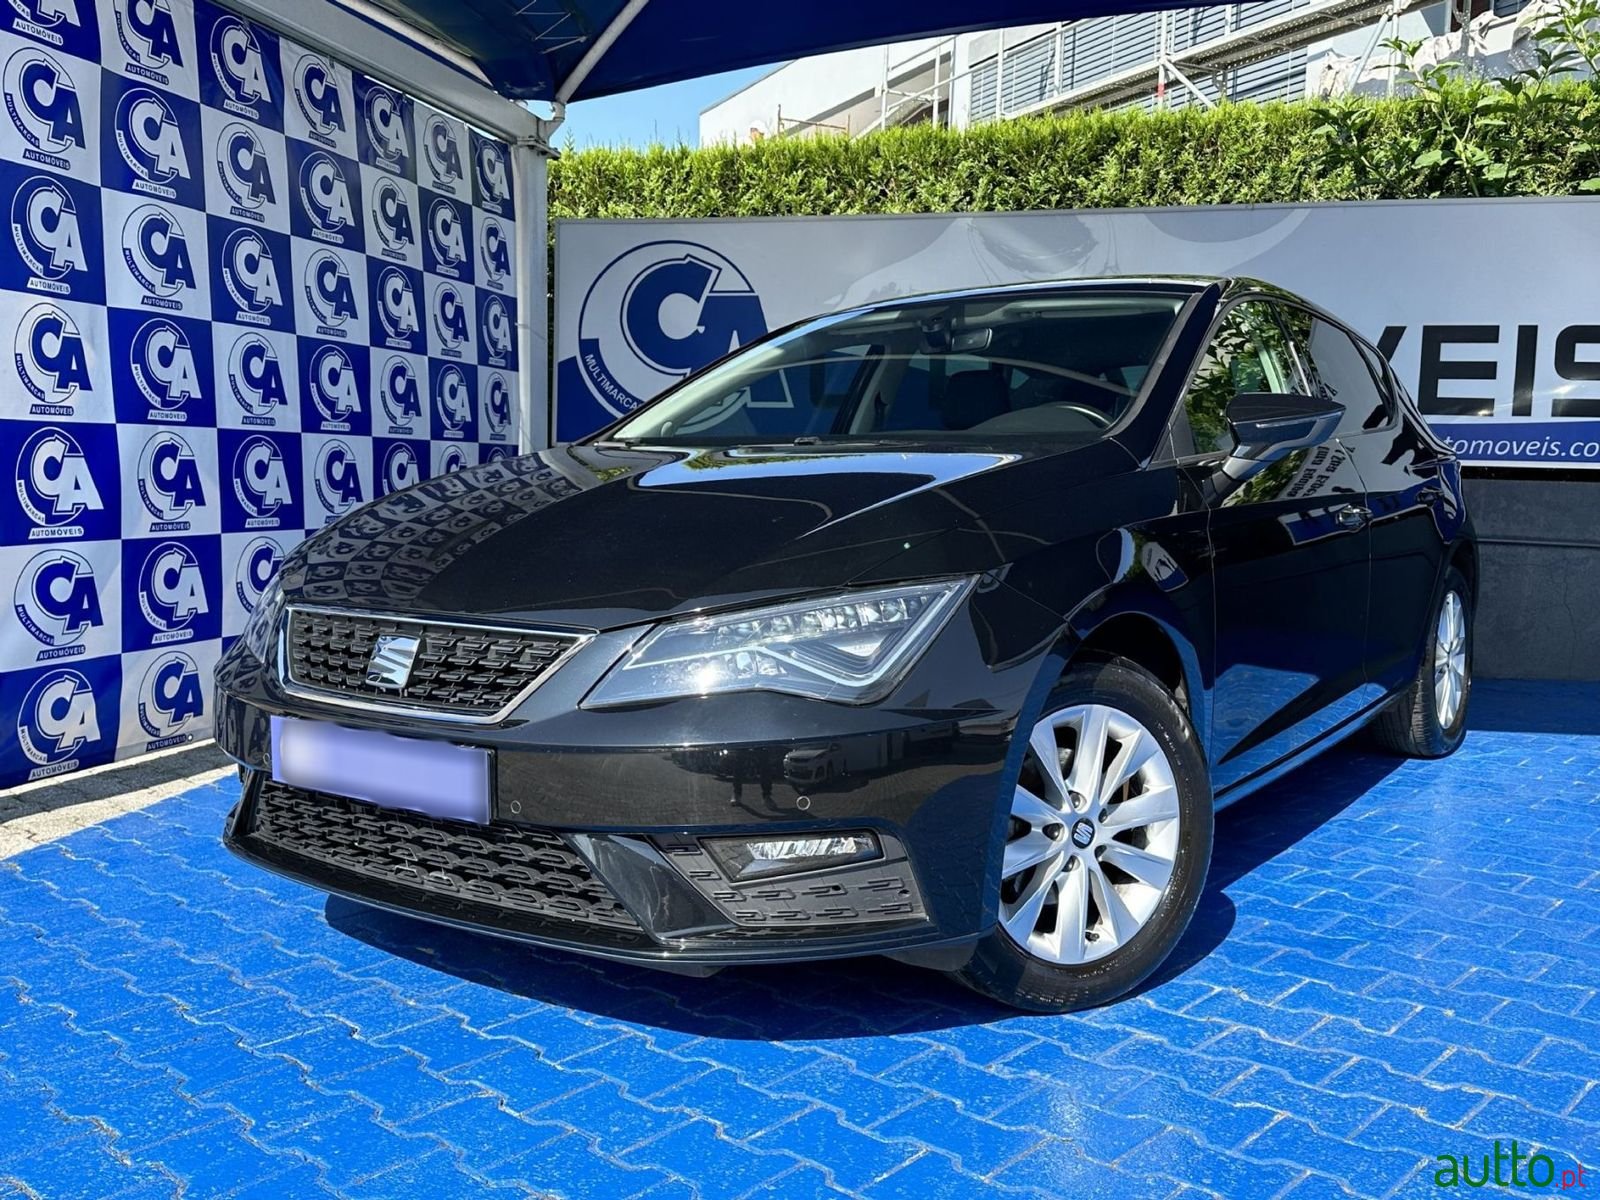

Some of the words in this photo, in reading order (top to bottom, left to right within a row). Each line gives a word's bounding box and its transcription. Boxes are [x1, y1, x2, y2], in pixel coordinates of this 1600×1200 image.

[224, 28, 271, 102] CA
[6, 95, 40, 147] MULTIMARCAS
[23, 63, 86, 149] CA
[304, 67, 346, 132] CA
[374, 97, 409, 158] CA
[131, 100, 190, 178] CA
[230, 134, 276, 204] CA
[433, 125, 463, 180] CA
[312, 163, 355, 226] CA
[381, 187, 415, 245] CA
[14, 226, 43, 274] MULTIMARCAS
[30, 190, 88, 271] CA
[141, 216, 196, 289] CA
[436, 208, 466, 262] CA
[236, 239, 282, 306] CA
[317, 260, 358, 319] CA
[386, 277, 419, 332] CA
[441, 292, 469, 342] CA
[16, 356, 45, 399] MULTIMARCAS
[32, 316, 92, 390] CA
[149, 329, 202, 398] CA
[242, 343, 288, 405] CA
[322, 352, 361, 412] CA
[585, 353, 643, 411] MULTIMARCA
[390, 364, 422, 417] CA
[443, 371, 472, 422] CA
[18, 482, 45, 522] MULTIMARCAS
[33, 438, 103, 510] CA
[152, 443, 206, 507] CA
[246, 445, 292, 504] CA
[326, 450, 363, 502] CA
[35, 560, 103, 628] CA
[154, 552, 208, 617] CA
[17, 606, 54, 644] MULTIMARCAS
[38, 679, 101, 750] CA
[155, 662, 204, 722] CA
[20, 729, 48, 762] MULTIMARCAS
